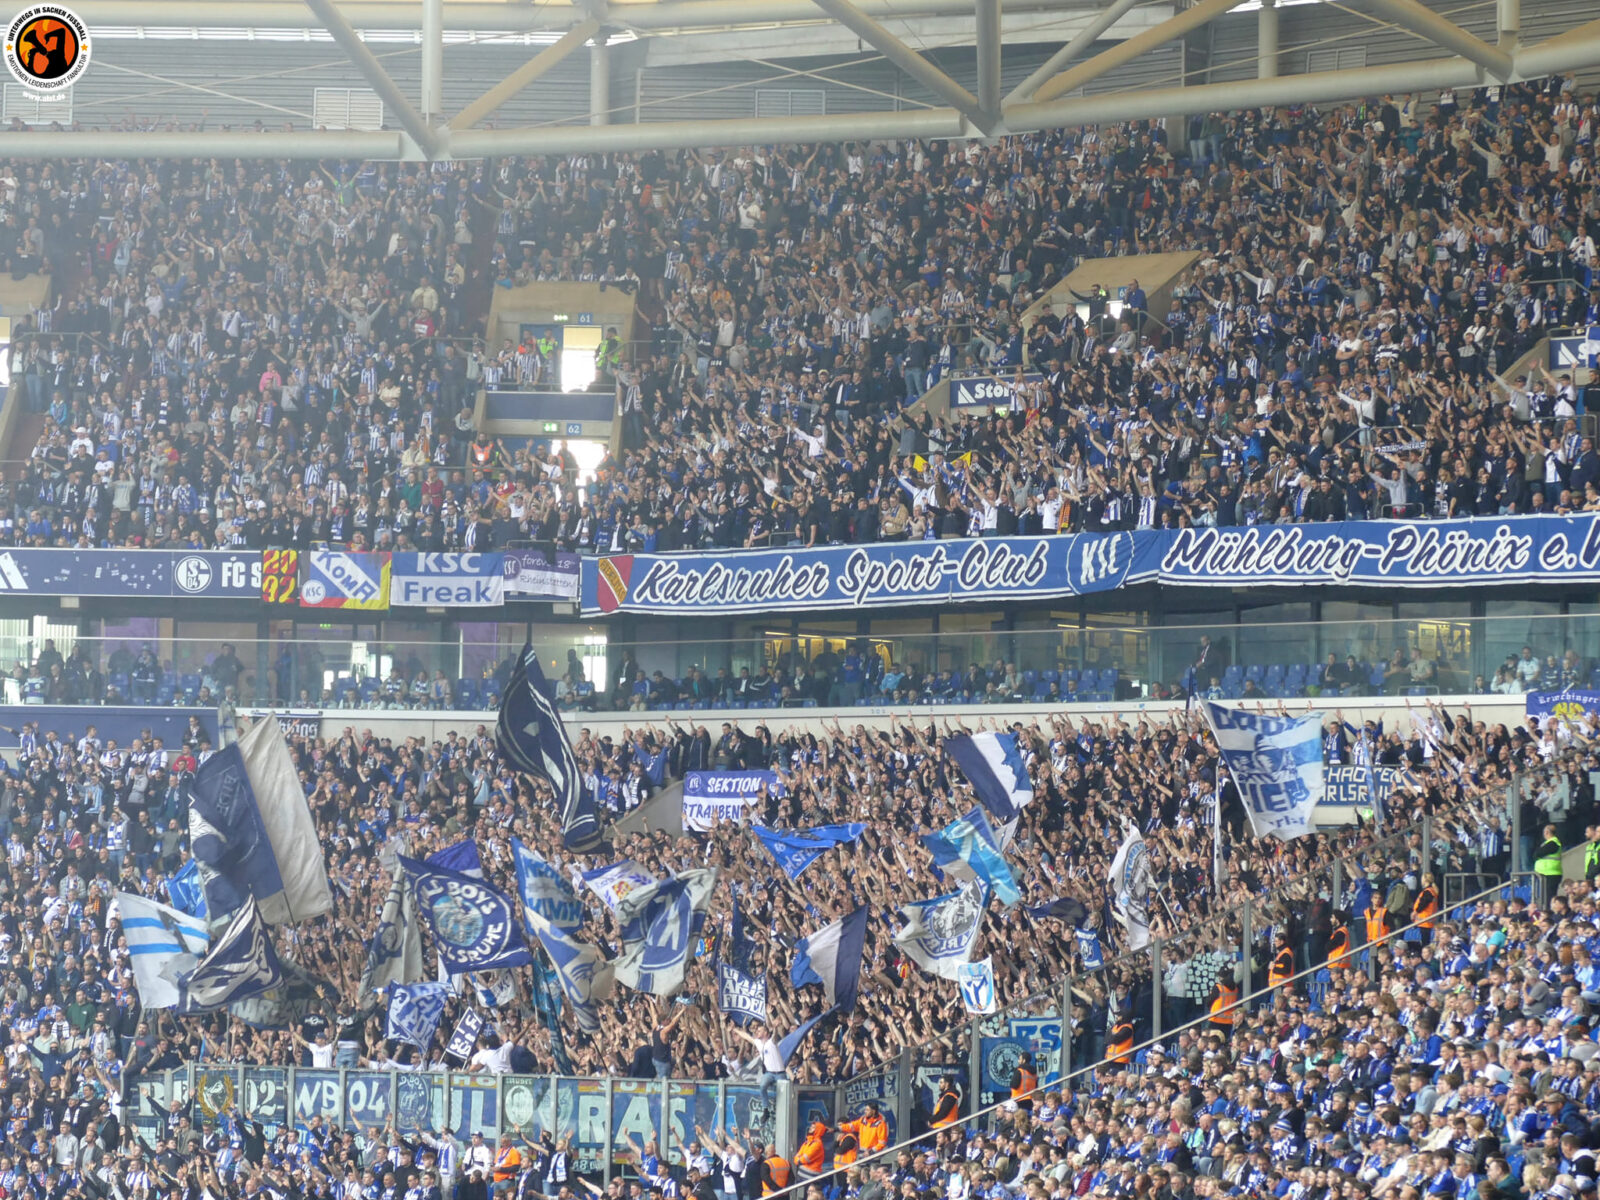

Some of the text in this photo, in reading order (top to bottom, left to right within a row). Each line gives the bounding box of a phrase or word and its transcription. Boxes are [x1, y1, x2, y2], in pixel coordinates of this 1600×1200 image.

[579, 314, 591, 323] 61
[568, 424, 580, 434] 62
[416, 552, 481, 574] KSC
[1161, 523, 1532, 584] Mühlburg-Phönix
[221, 561, 246, 588] FC
[633, 539, 1050, 605] Karlsruher Sport-Club
[305, 586, 322, 598] KSC
[404, 580, 492, 603] Freak
[707, 776, 762, 793] SEKTION
[447, 881, 497, 915] BOYS
